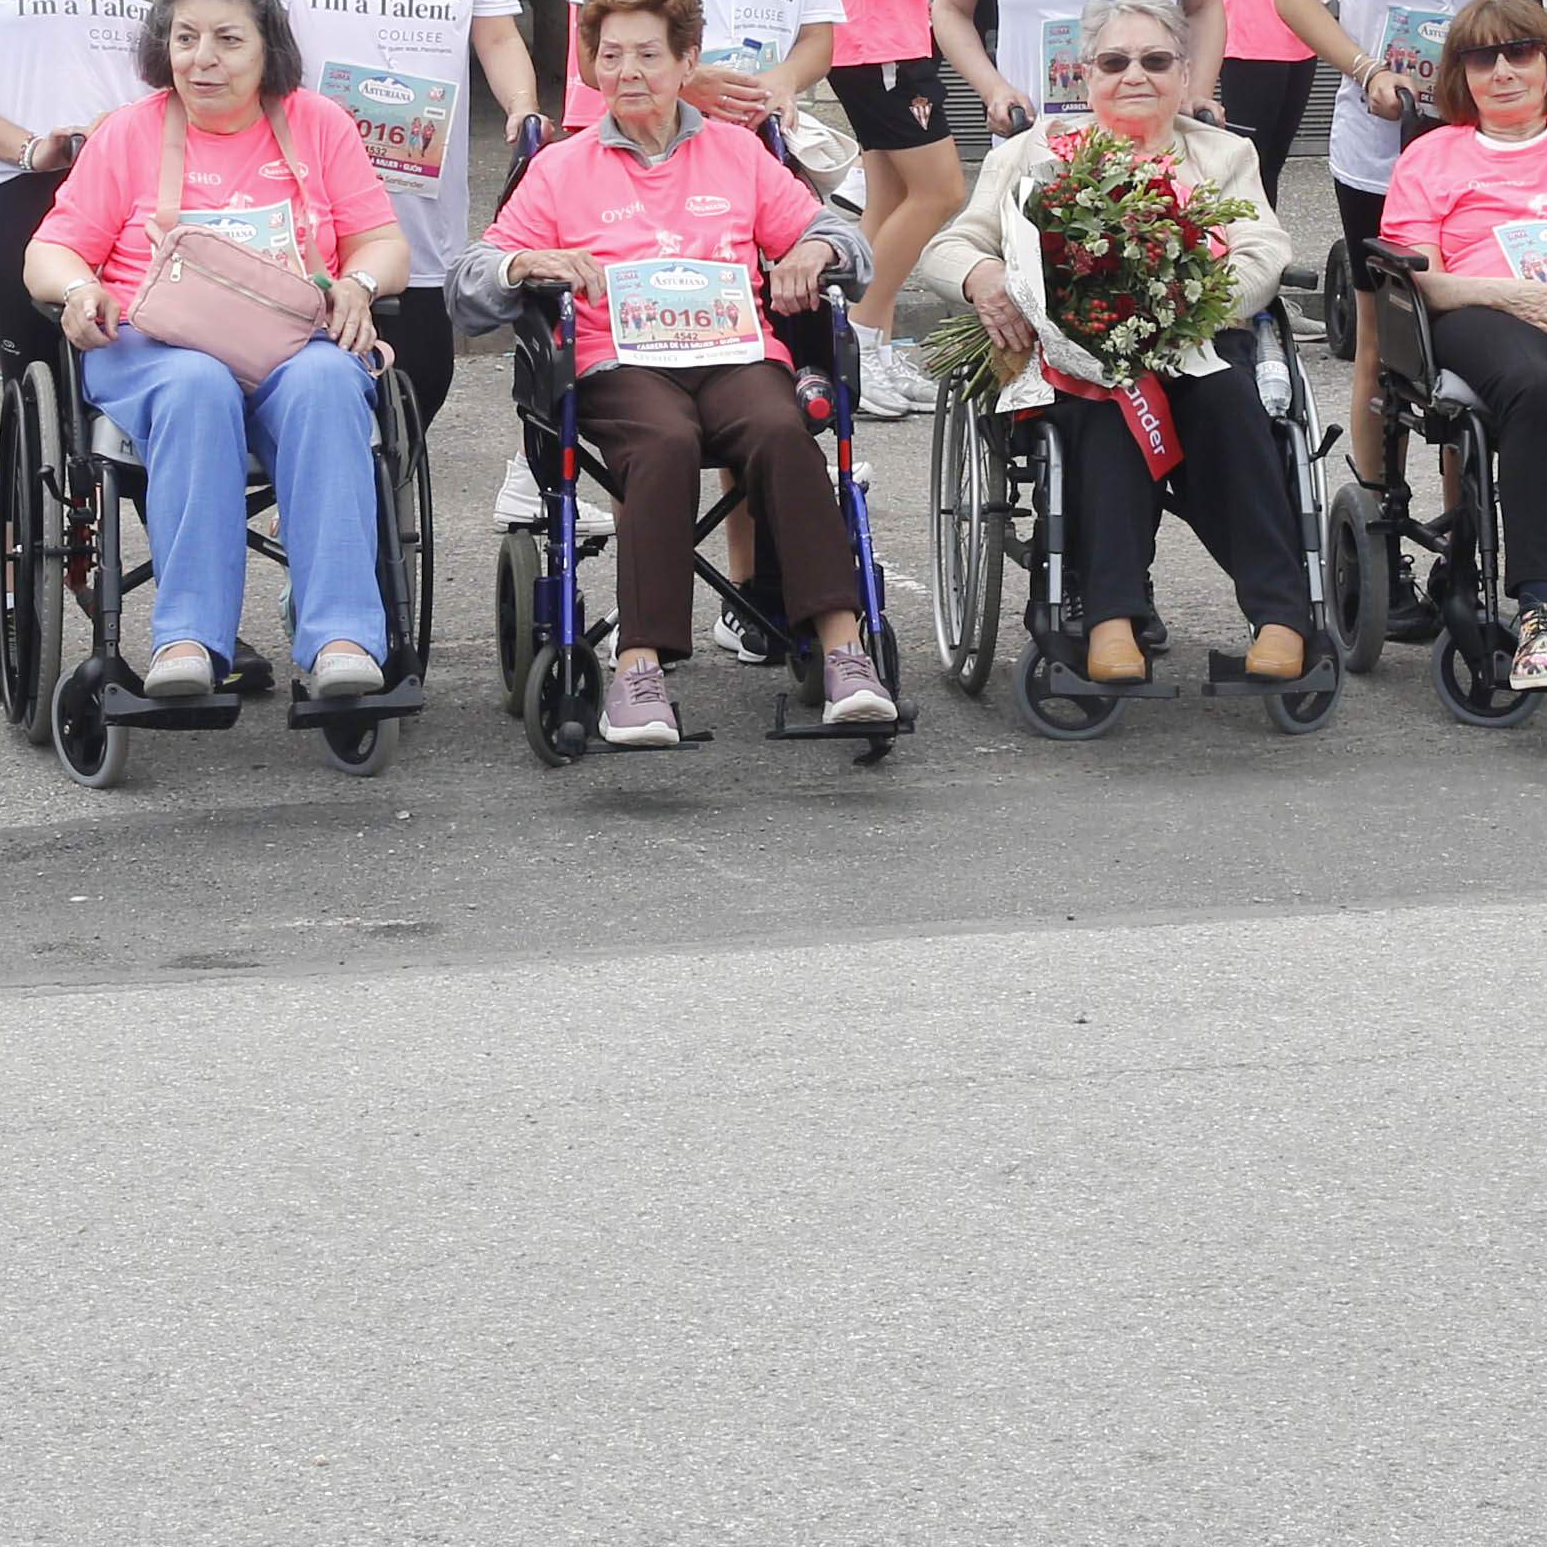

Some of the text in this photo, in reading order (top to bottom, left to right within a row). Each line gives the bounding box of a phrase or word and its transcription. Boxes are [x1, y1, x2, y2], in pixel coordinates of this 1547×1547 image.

[64, 0, 78, 15] a
[355, 1, 369, 15] a
[377, 28, 444, 44] COLISEE
[360, 81, 412, 103] ASTURIANA
[358, 118, 405, 145] 016
[188, 171, 222, 186] SHO
[601, 200, 646, 224] OYSH
[659, 308, 712, 328] 016
[673, 331, 699, 341] 4542
[636, 342, 669, 352] CARRERA
